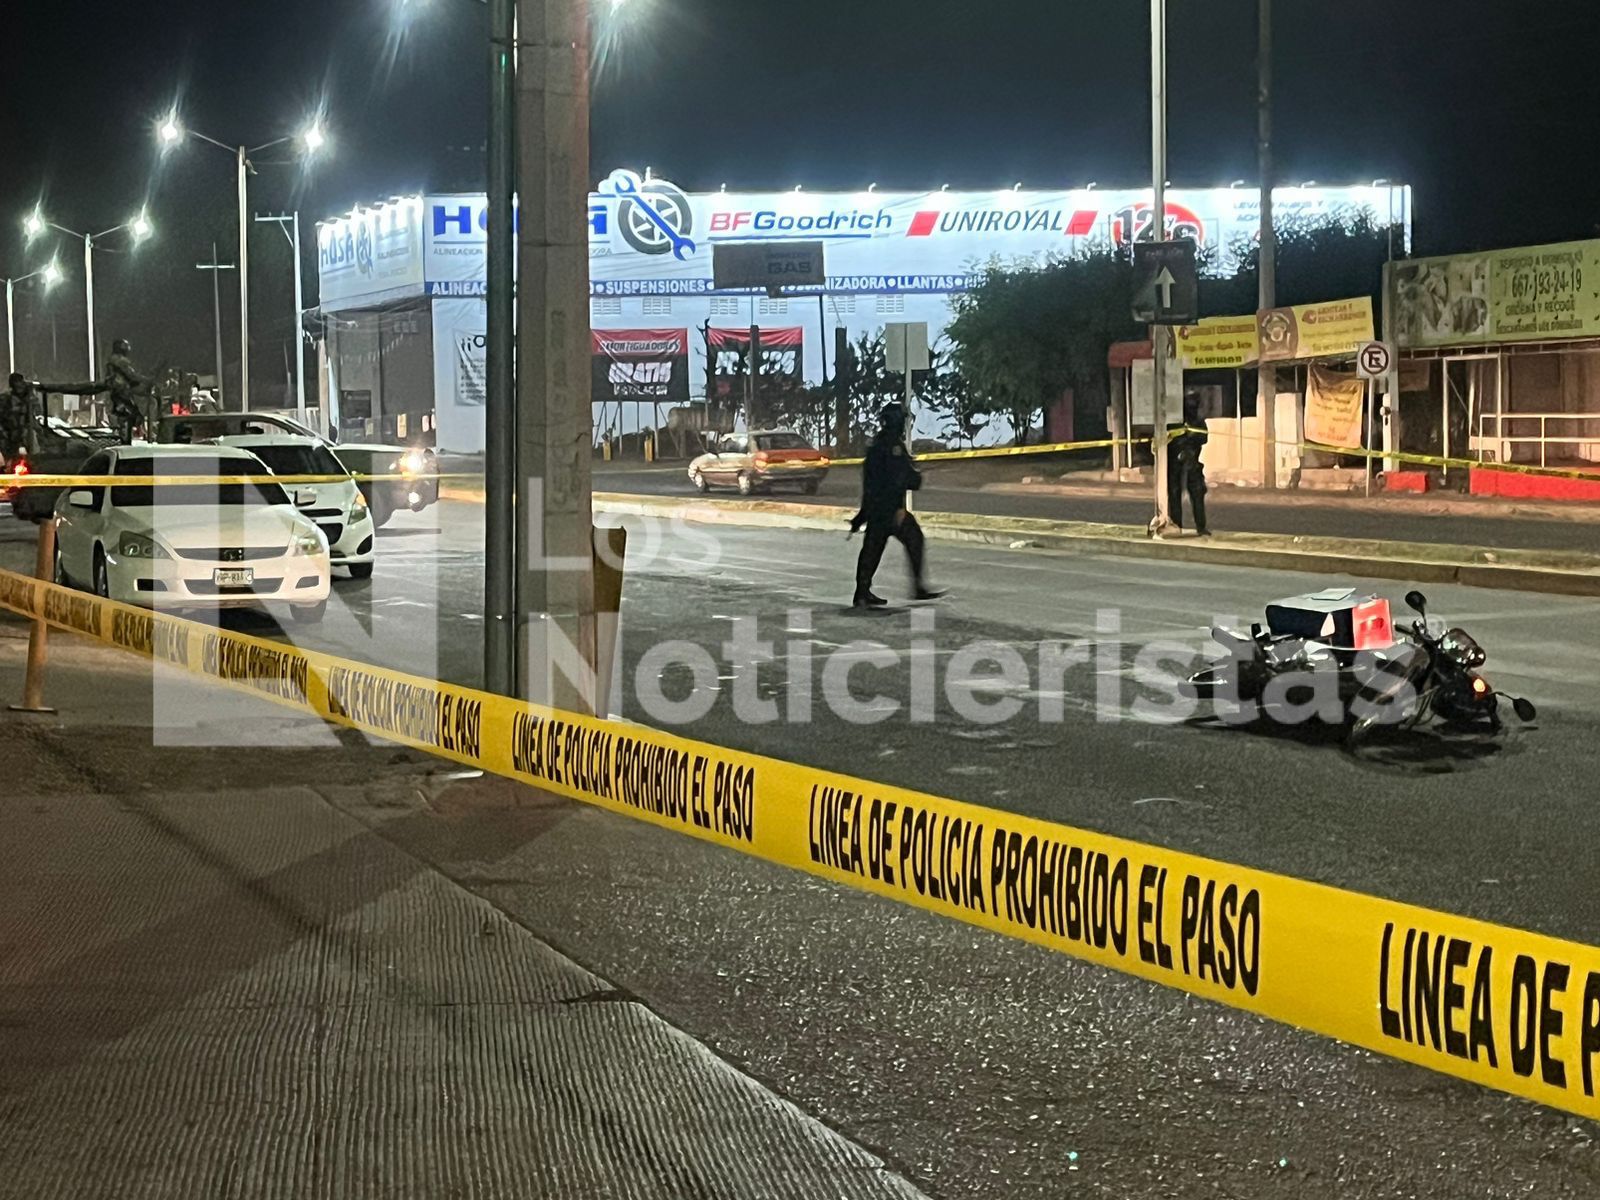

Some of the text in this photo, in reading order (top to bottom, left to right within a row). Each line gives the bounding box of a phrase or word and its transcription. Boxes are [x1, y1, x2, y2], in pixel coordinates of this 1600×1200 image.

[710, 209, 892, 231] BFGoodrich
[940, 210, 1063, 232] UNIROYAL
[606, 279, 705, 294] SUSPENSIONES
[897, 275, 953, 289] LLANTAS
[512, 711, 755, 844] LINEA DE POLICIA PROHIBIDO EL PASO
[808, 783, 1261, 997] LINEA DE POLICIA PROHIBIDO EL PASO
[1379, 922, 1499, 1069] LINEA
[1510, 954, 1571, 1090] DE
